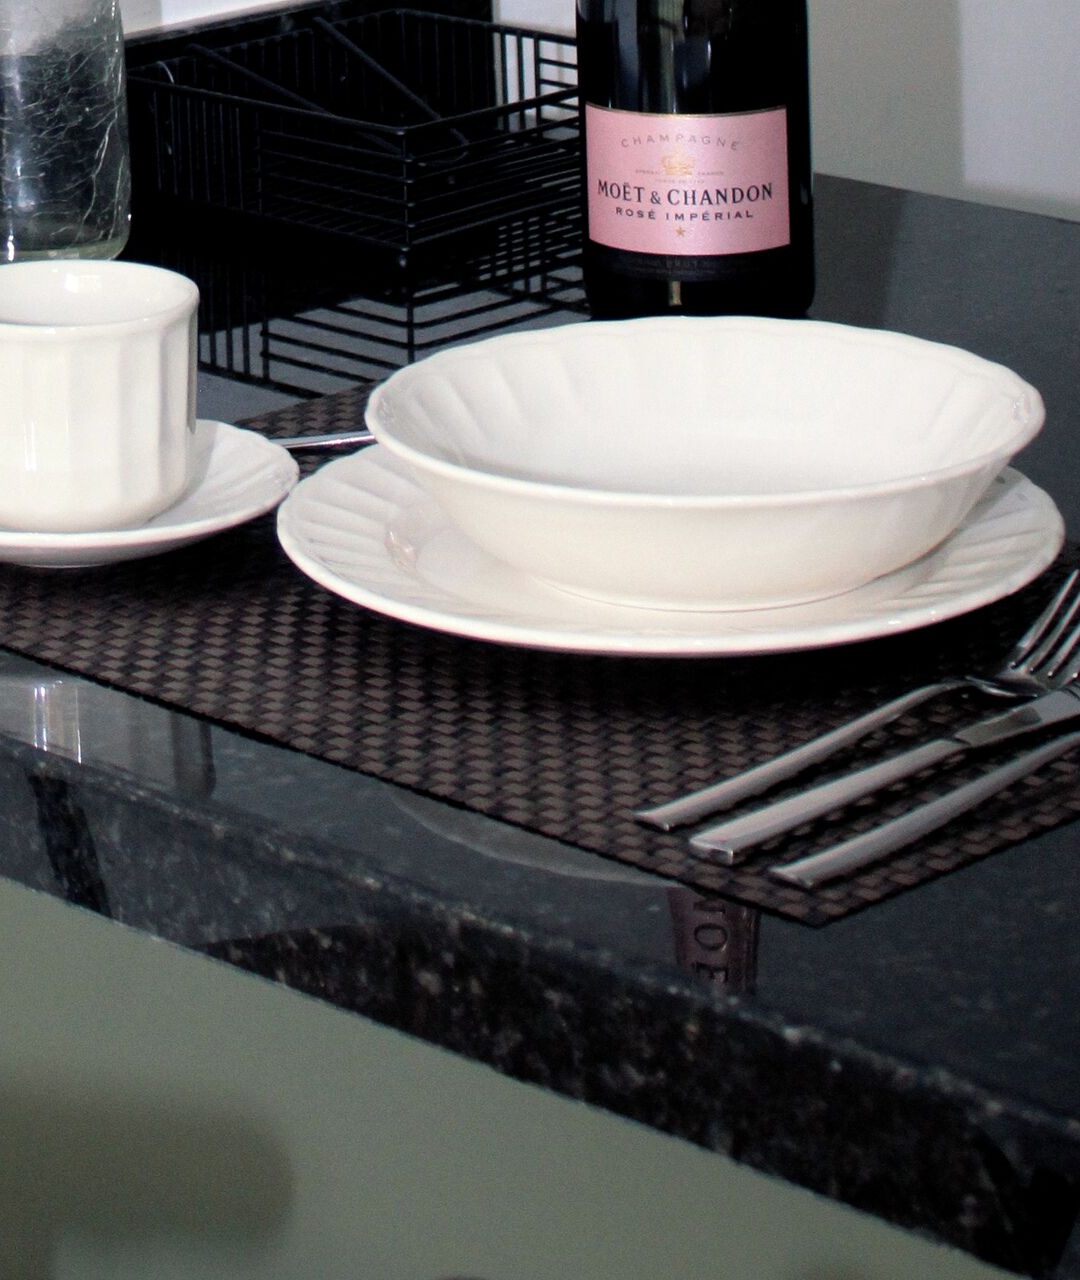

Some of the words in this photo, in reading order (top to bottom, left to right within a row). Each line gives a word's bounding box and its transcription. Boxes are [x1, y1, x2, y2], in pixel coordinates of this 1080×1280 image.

[621, 133, 740, 151] CHAMPAGNE
[597, 179, 645, 203] MOËT
[650, 192, 661, 205] &
[667, 183, 773, 206] CHANDON
[615, 207, 656, 220] ROSÉ
[665, 210, 753, 221] IMPÉRIAL
